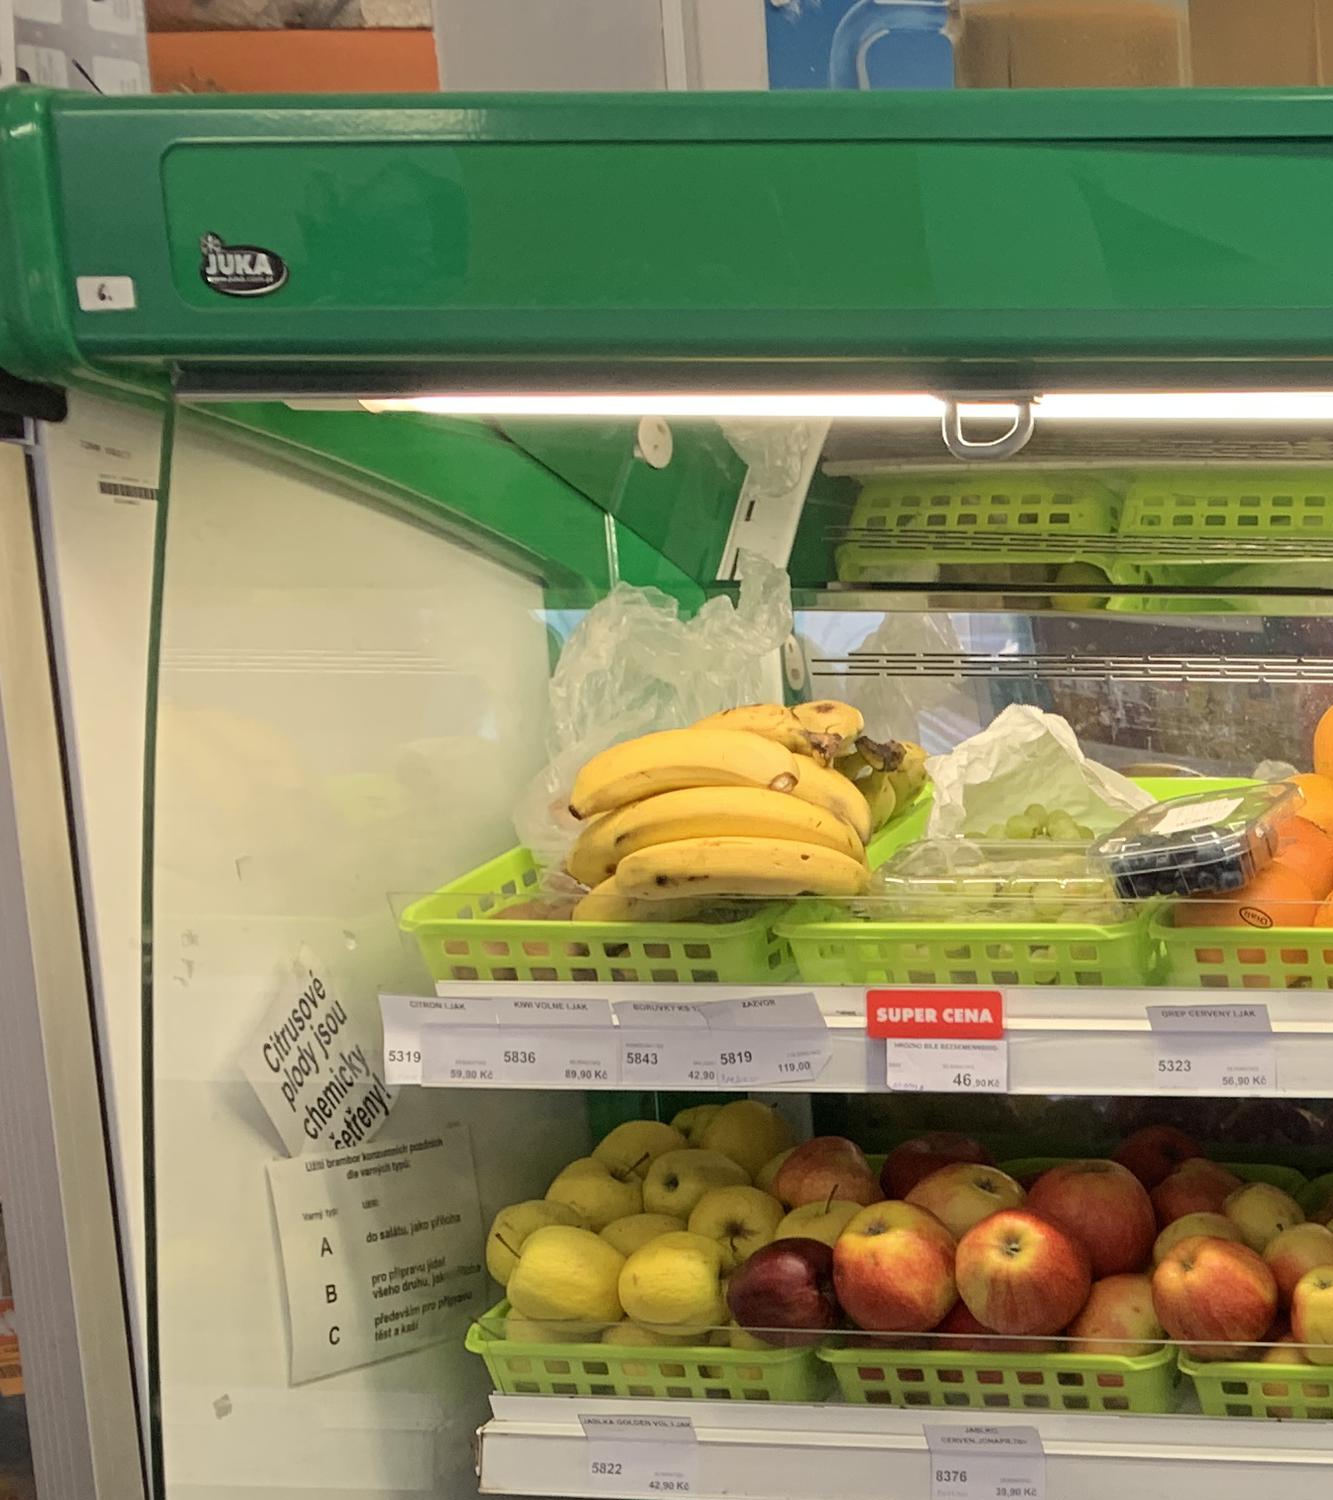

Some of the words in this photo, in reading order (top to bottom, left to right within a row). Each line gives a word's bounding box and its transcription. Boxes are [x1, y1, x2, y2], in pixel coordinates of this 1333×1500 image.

[205, 252, 274, 276] JUKA
[261, 968, 328, 1074] Citrusové
[876, 1007, 937, 1023] SUPER
[942, 1007, 993, 1024] CENA
[279, 1046, 319, 1113] plody
[313, 998, 349, 1052] jsou
[388, 1050, 422, 1064] 5319
[503, 1050, 536, 1064] 5836
[626, 1052, 659, 1066] 5843
[719, 1051, 753, 1065] 5819
[1158, 1060, 1192, 1073] 5323
[303, 1041, 371, 1142] chemicky
[320, 1237, 333, 1258] A
[325, 1284, 338, 1303] B
[328, 1326, 341, 1345] C
[591, 1461, 623, 1476] 5822
[935, 1469, 968, 1484] 8376
